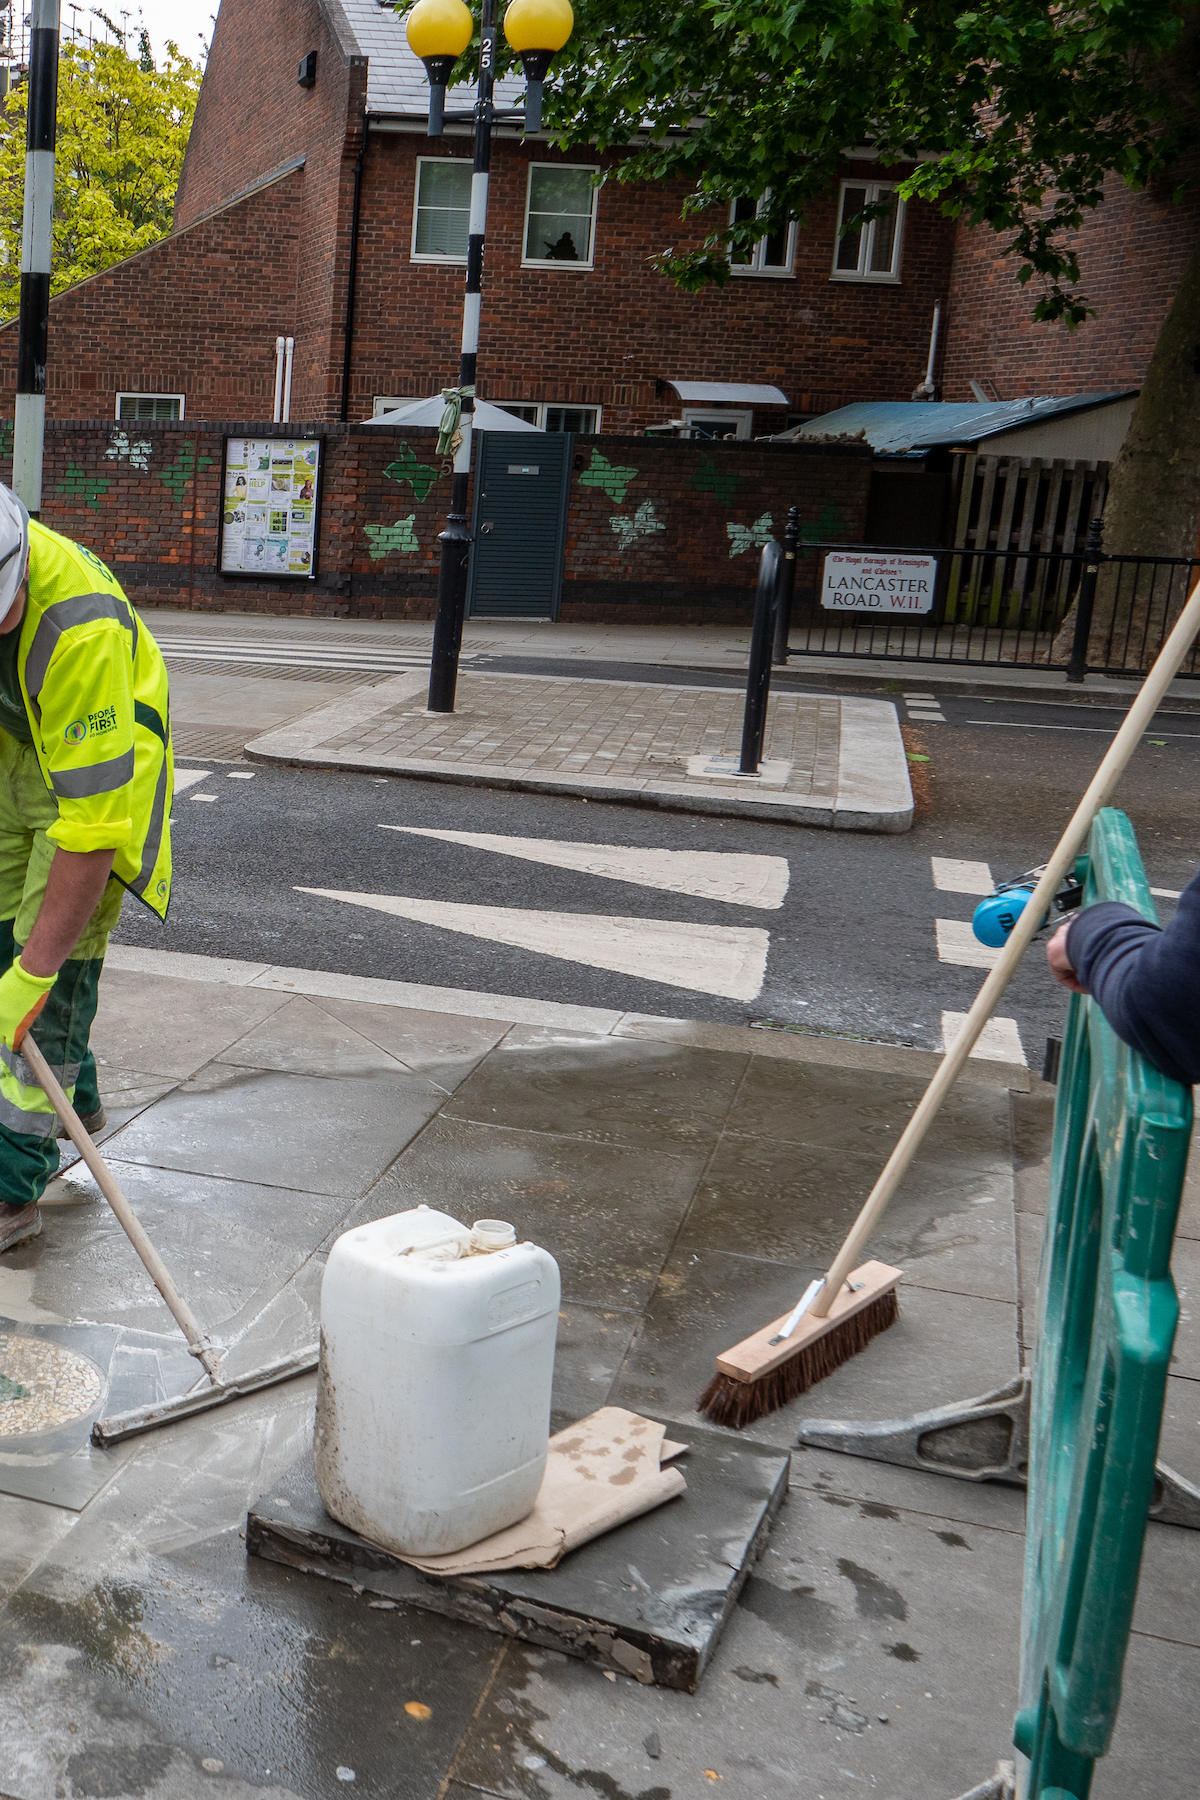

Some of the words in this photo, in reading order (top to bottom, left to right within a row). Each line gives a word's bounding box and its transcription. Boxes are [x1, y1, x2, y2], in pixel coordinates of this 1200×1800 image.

[481, 38, 492, 69] 25
[845, 556, 862, 565] Royal
[864, 557, 887, 566] Borough
[898, 558, 930, 568] Kensington
[827, 576, 929, 593] LANCASTER
[832, 592, 883, 608] ROAD.
[87, 705, 115, 723] PEOPLE
[90, 713, 117, 733] FIRST
